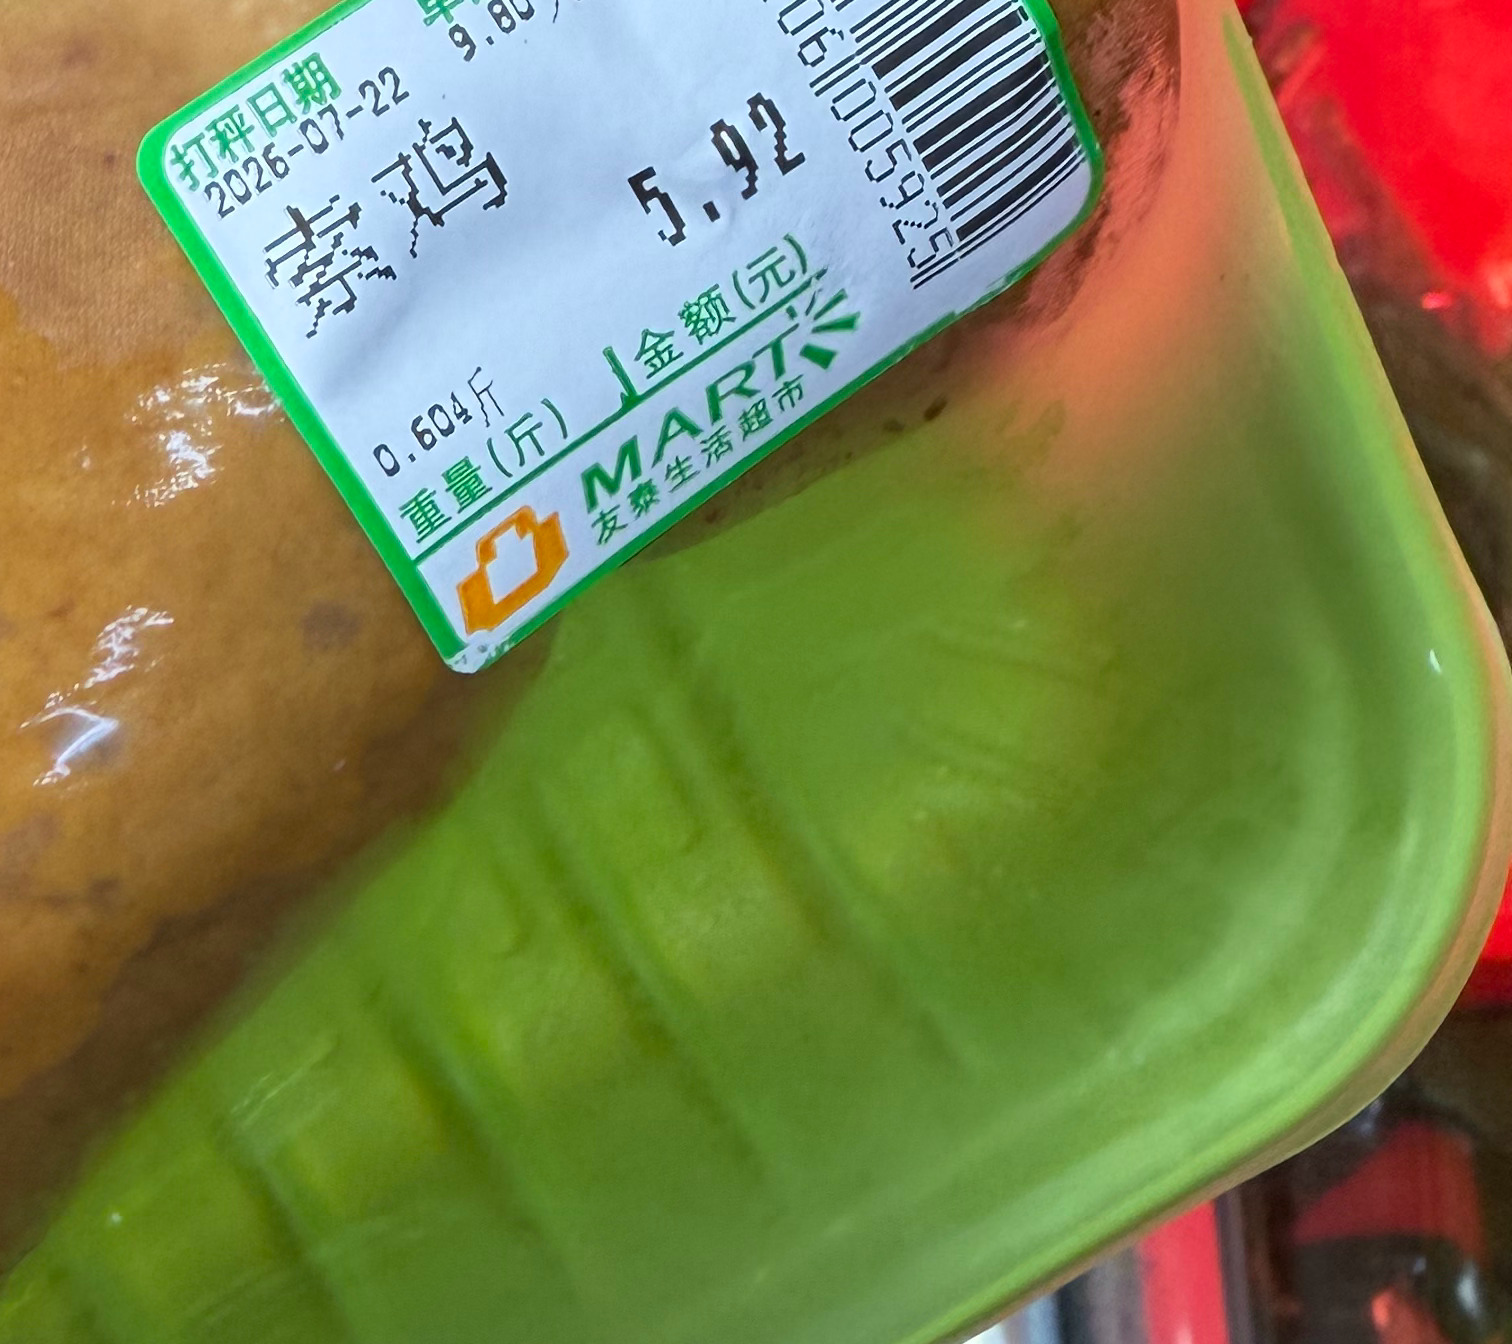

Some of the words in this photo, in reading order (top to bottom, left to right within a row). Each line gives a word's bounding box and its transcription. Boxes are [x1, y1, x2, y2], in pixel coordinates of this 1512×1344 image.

[172, 52, 342, 191] 打秤日期
[204, 67, 409, 218] 2026-07-22
[627, 92, 806, 246] 5.92
[263, 117, 507, 339] 素鸡
[633, 233, 808, 380] 金额(元)
[398, 398, 568, 544] 重量(斤)
[580, 323, 800, 514] MART
